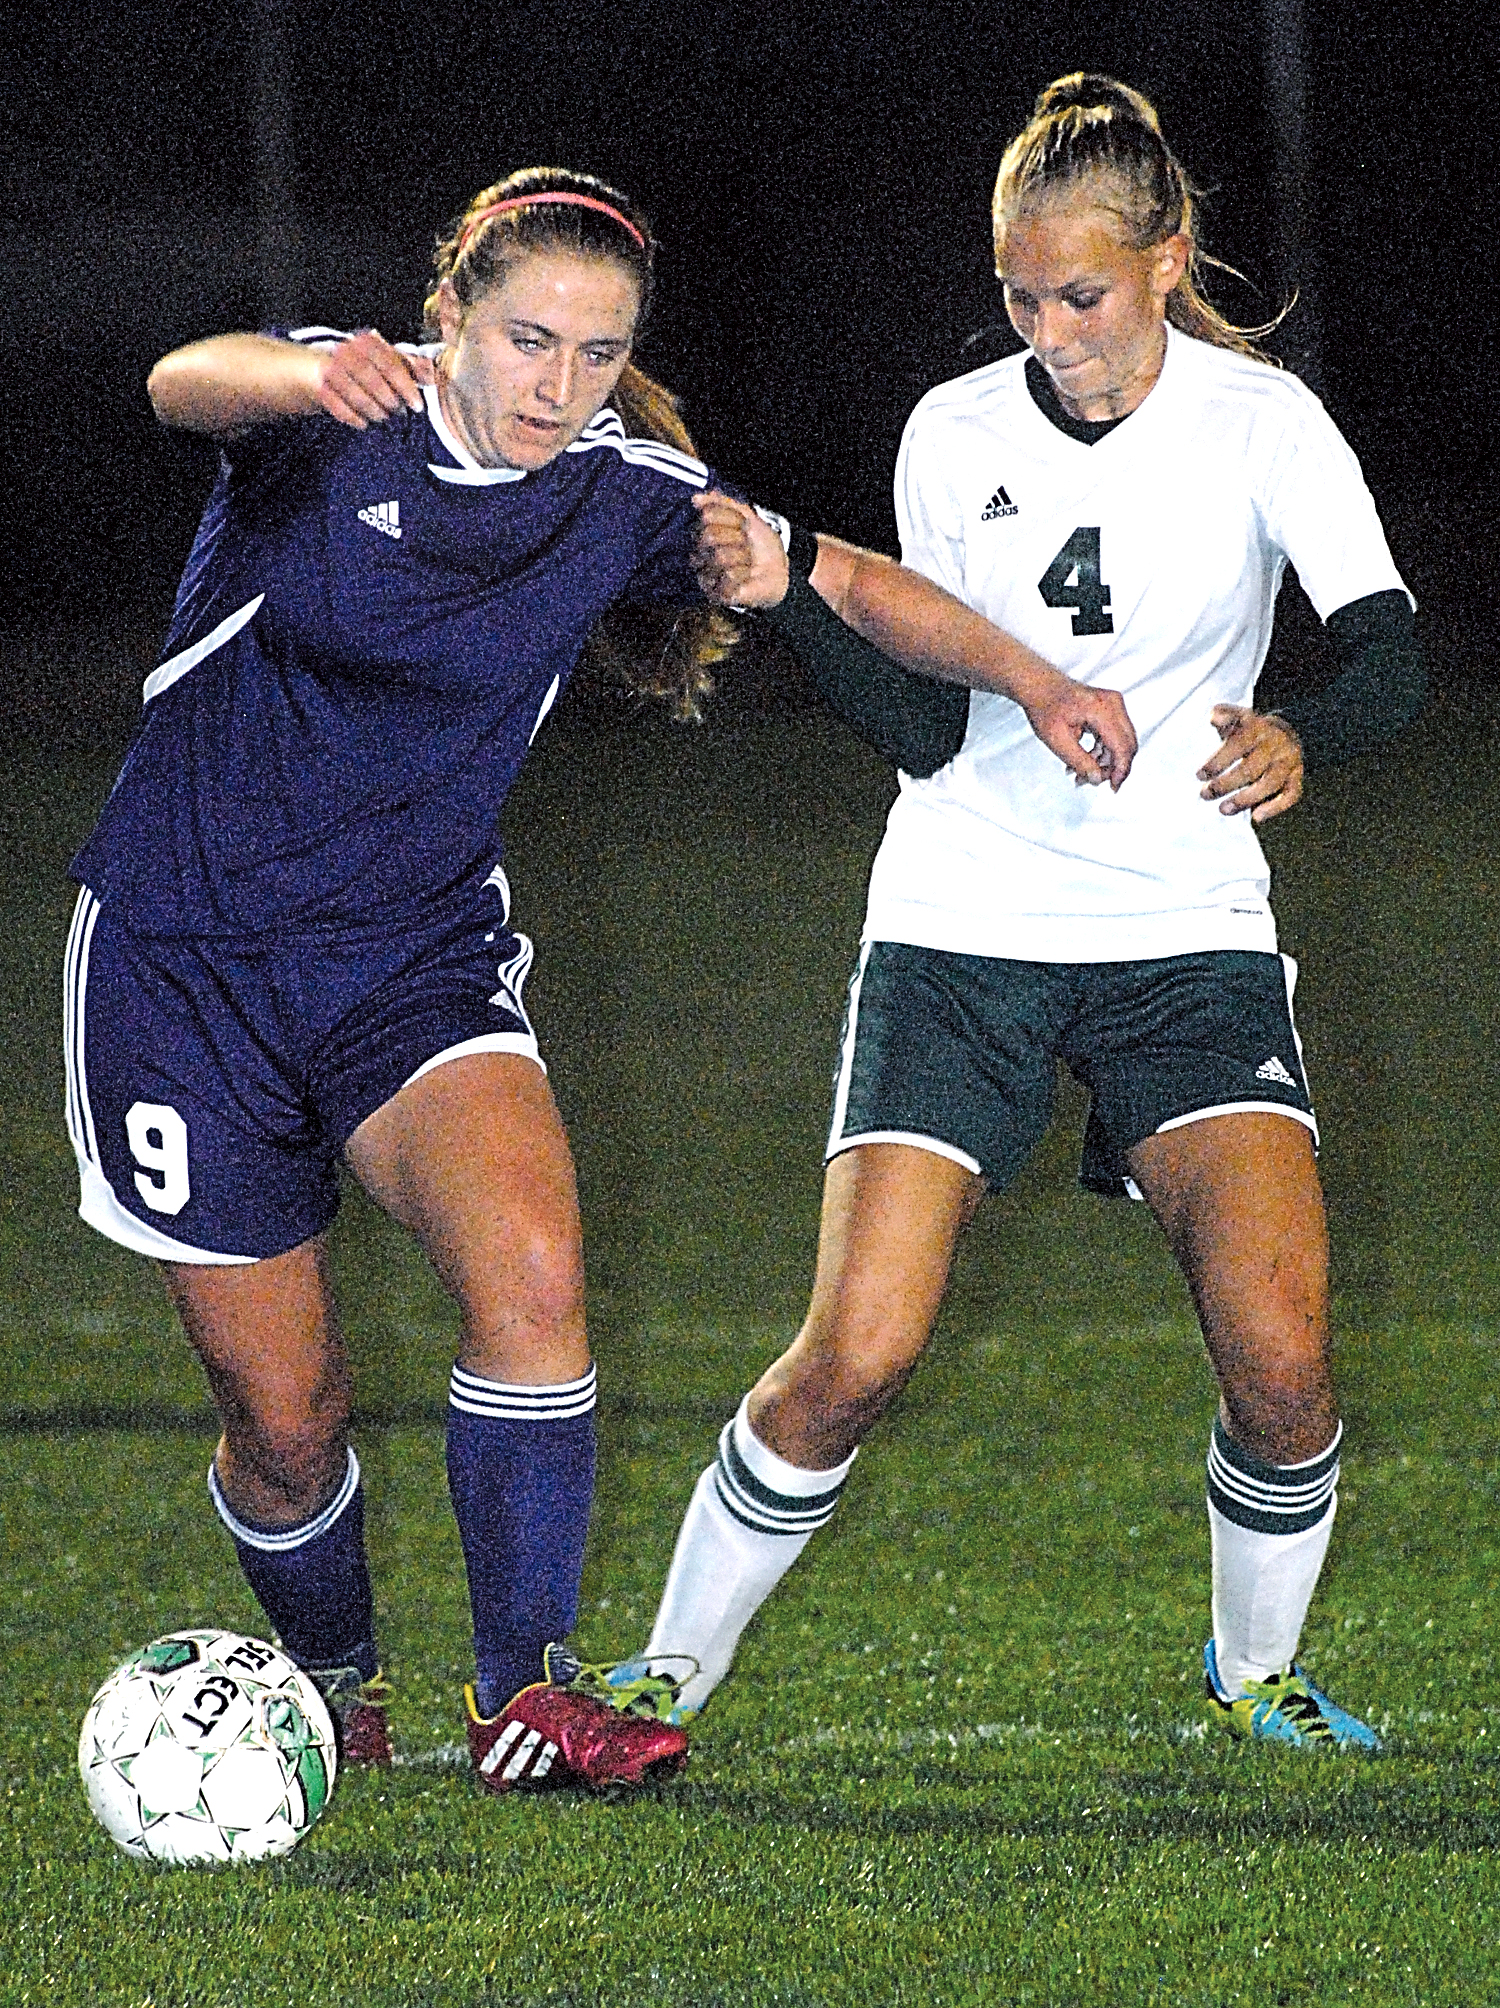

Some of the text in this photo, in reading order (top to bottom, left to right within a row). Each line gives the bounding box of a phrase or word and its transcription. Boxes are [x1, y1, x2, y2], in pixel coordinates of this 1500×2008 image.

[357, 509, 402, 539] adidas
[981, 504, 1019, 521] adidas
[1037, 526, 1114, 636] 4
[125, 1101, 191, 1216] 9
